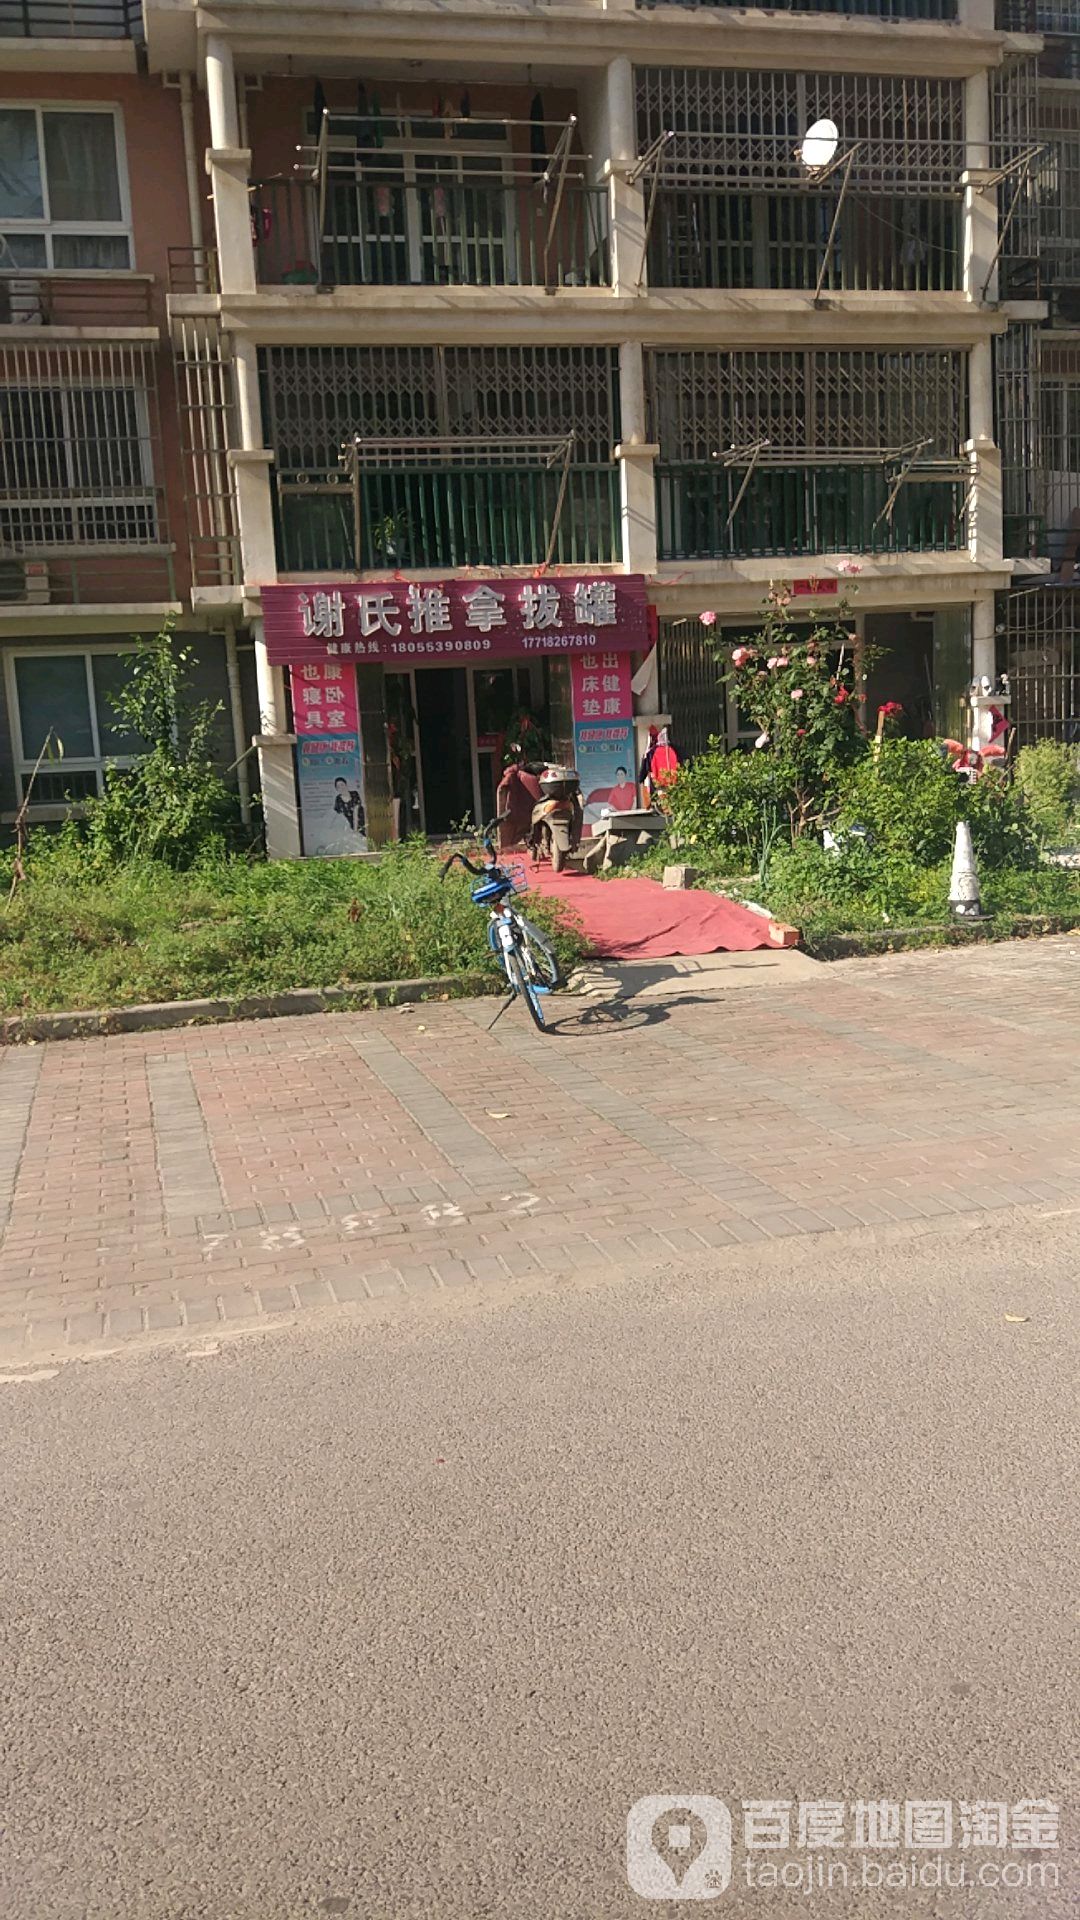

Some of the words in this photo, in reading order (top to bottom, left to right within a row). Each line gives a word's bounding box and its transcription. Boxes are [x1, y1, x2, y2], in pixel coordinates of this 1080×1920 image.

[298, 582, 617, 637] 谢氏推拿拔罐
[522, 634, 596, 649] 17718267810
